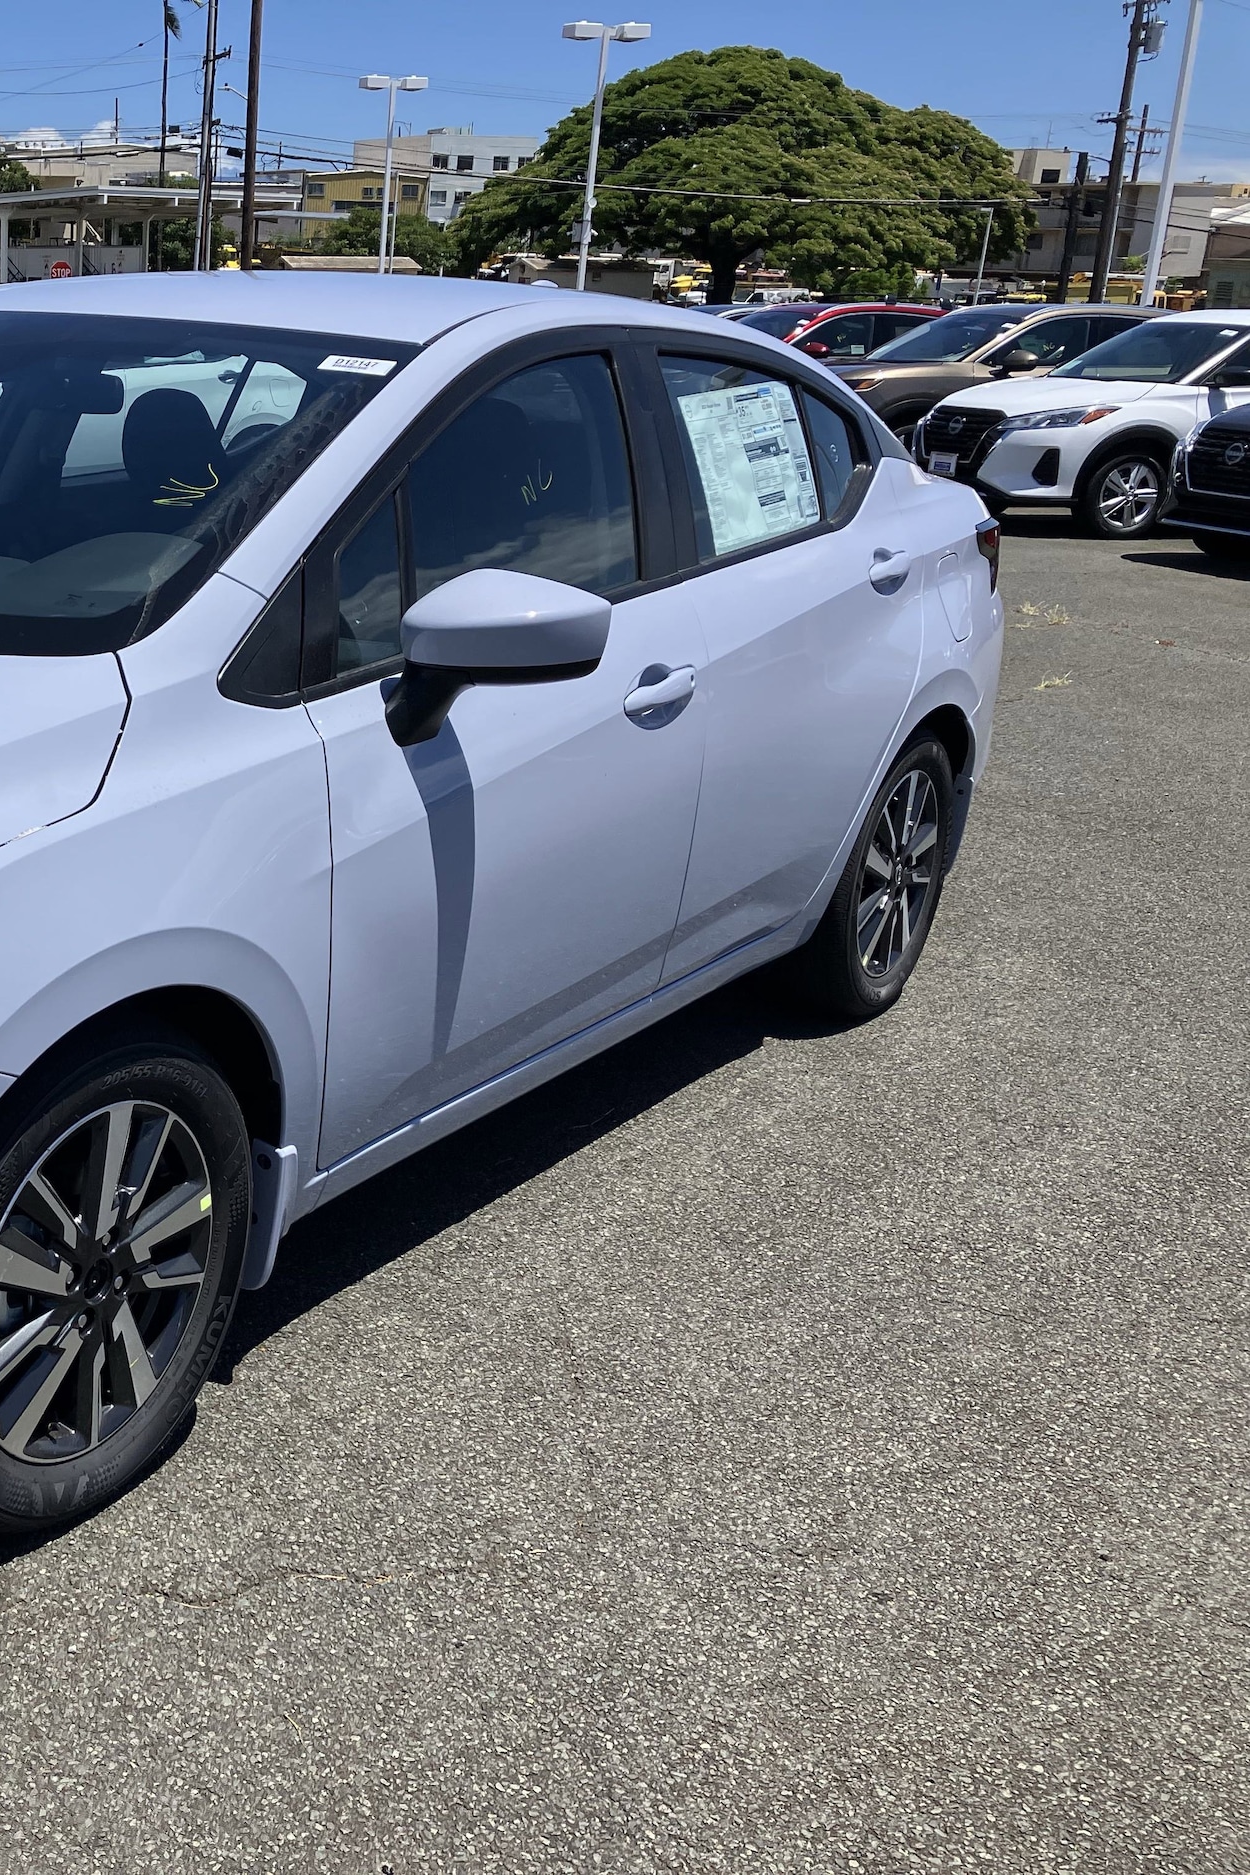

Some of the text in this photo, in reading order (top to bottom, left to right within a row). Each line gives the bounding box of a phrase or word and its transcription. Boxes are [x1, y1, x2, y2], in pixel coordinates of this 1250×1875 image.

[51, 267, 71, 278] STOP
[334, 358, 379, 368] D12147
[100, 1065, 153, 1090] 205/55
[163, 1295, 233, 1424] KUMHO
